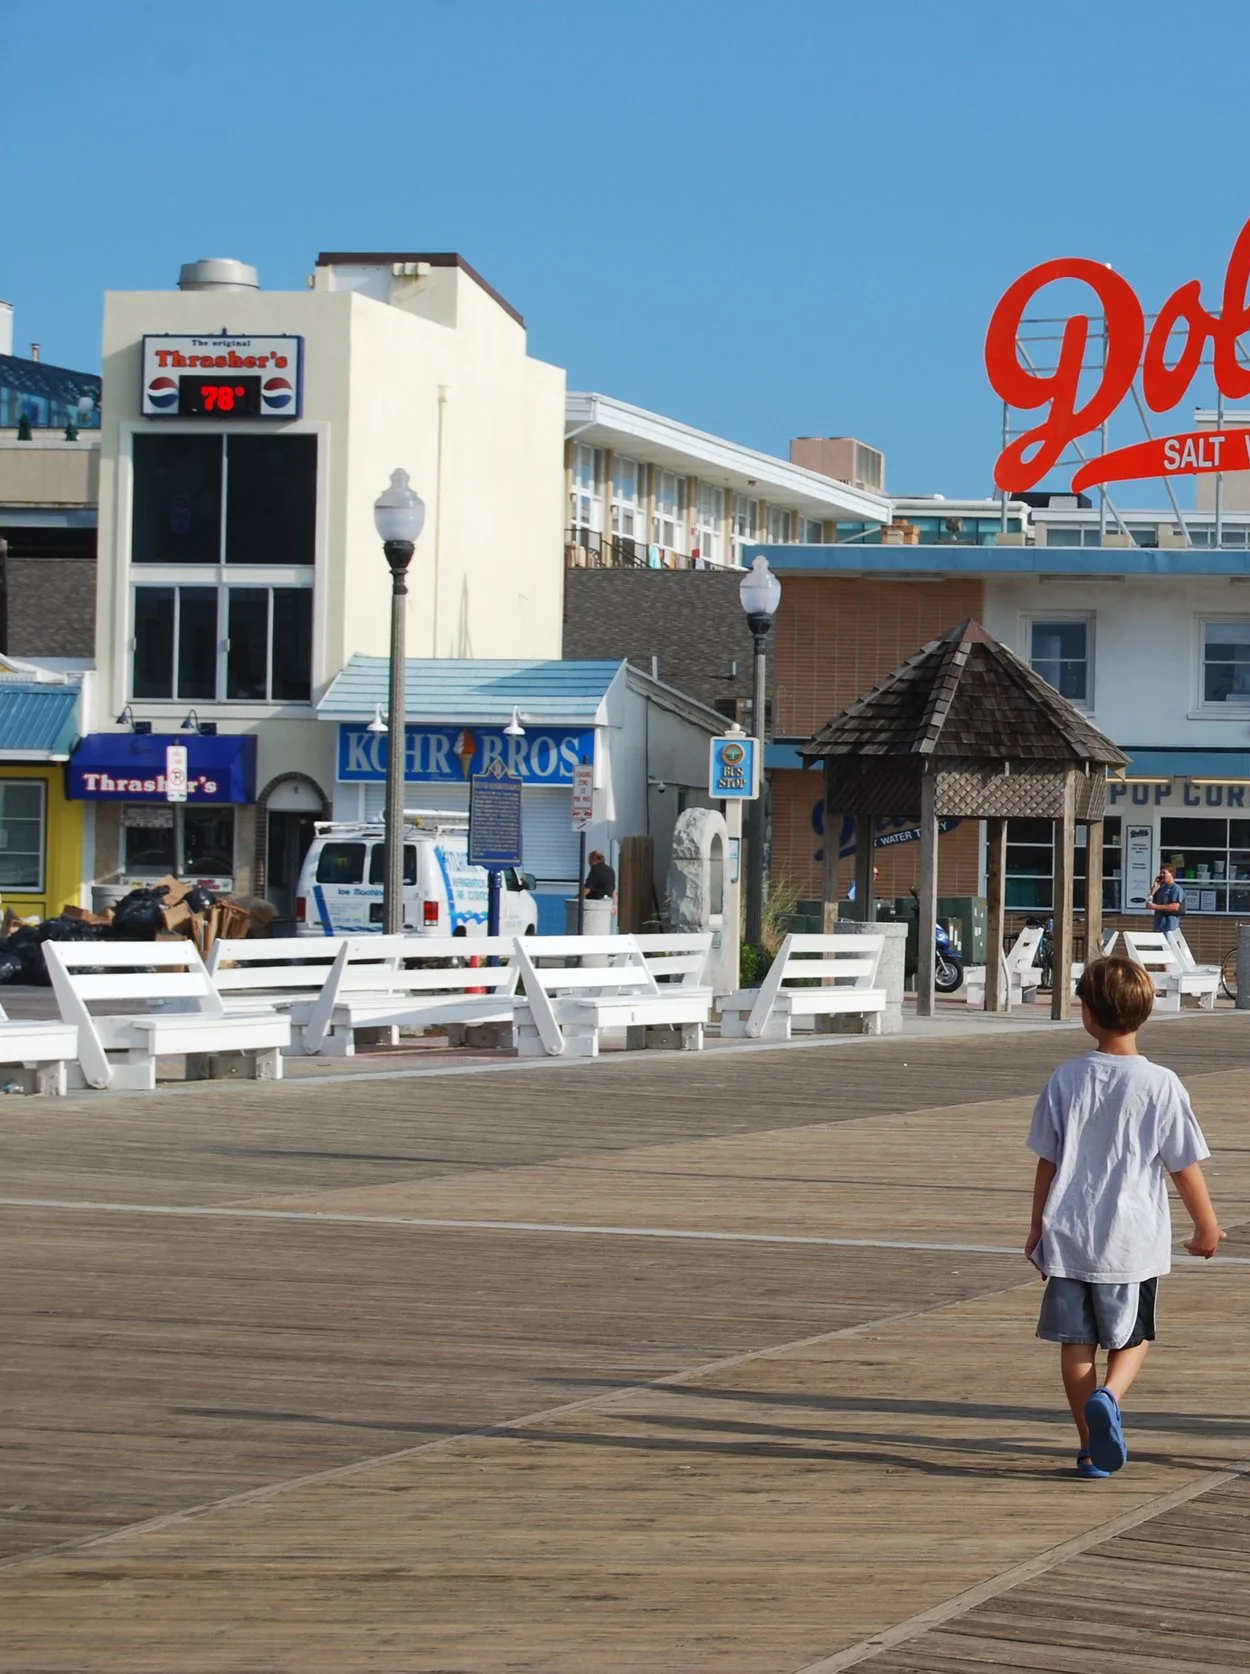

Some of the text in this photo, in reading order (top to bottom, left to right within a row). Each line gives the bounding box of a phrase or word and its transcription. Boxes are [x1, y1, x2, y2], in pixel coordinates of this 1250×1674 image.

[212, 339, 251, 348] original
[155, 350, 288, 369] Thrasher's
[1163, 436, 1225, 470] SALT
[345, 731, 452, 773] KOHR
[480, 735, 580, 777] BROS
[723, 766, 744, 777] BUS
[83, 773, 217, 793] Thrashr's
[719, 778, 746, 790] STOP
[1110, 783, 1171, 806] POP
[881, 832, 912, 847] WATER
